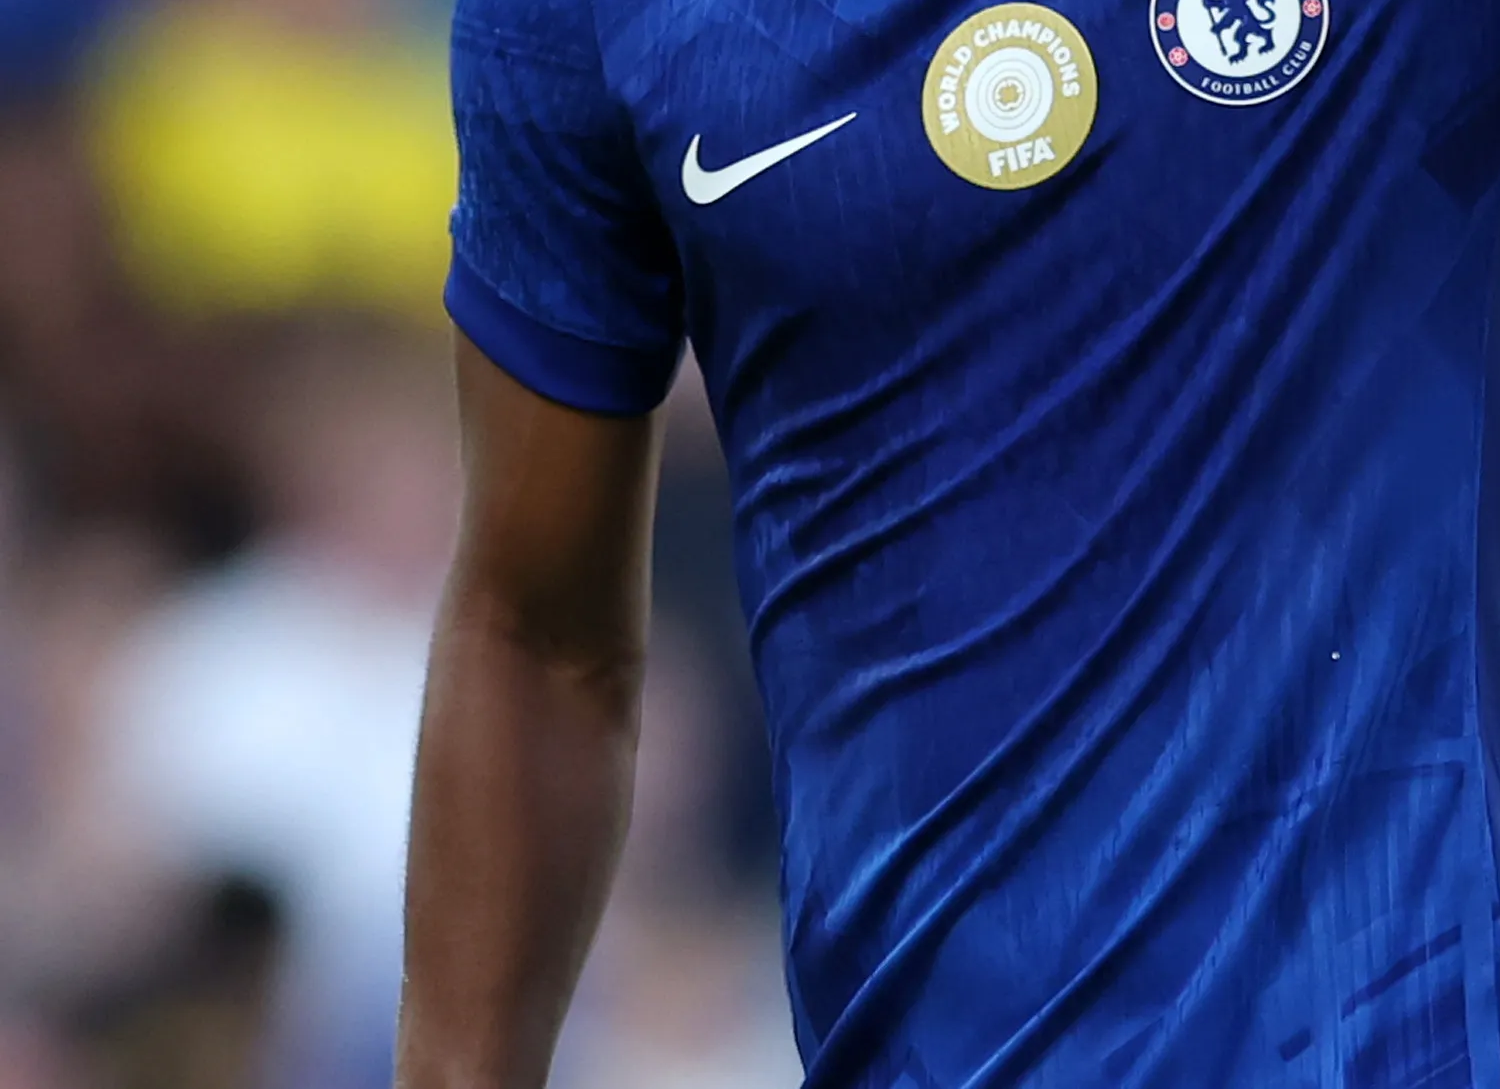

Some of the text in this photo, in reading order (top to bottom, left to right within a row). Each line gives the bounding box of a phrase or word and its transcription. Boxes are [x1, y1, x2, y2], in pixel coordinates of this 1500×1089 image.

[938, 19, 1080, 135] WORLD CHAMPIONS
[1201, 41, 1313, 95] FOOTBALL CLUB
[988, 136, 1056, 177] FIFA
